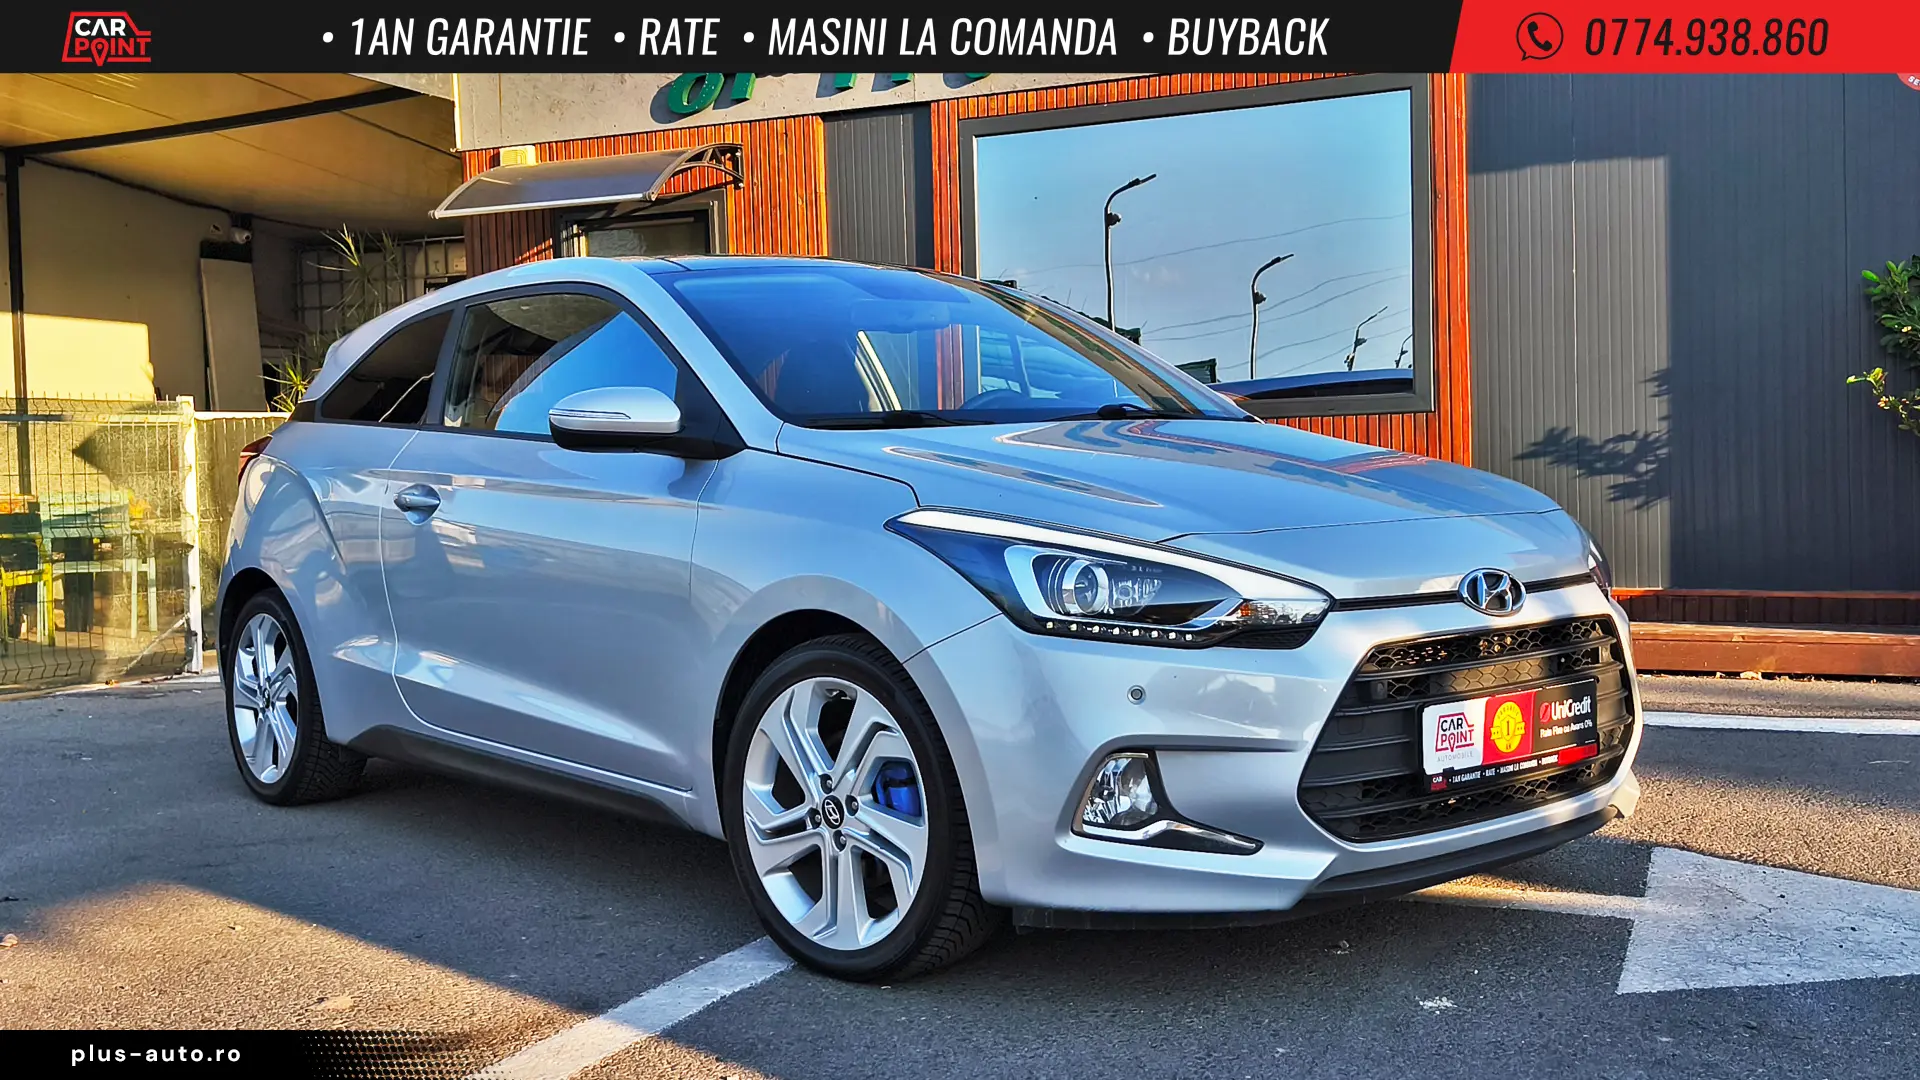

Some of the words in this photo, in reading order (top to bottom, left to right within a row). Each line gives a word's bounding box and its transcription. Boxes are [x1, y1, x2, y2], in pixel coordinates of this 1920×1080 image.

[1551, 695, 1591, 721] UniCredit
[1440, 717, 1464, 732] CAR
[1440, 729, 1474, 752] POINT
[1437, 750, 1473, 762] AUTOMOBILE
